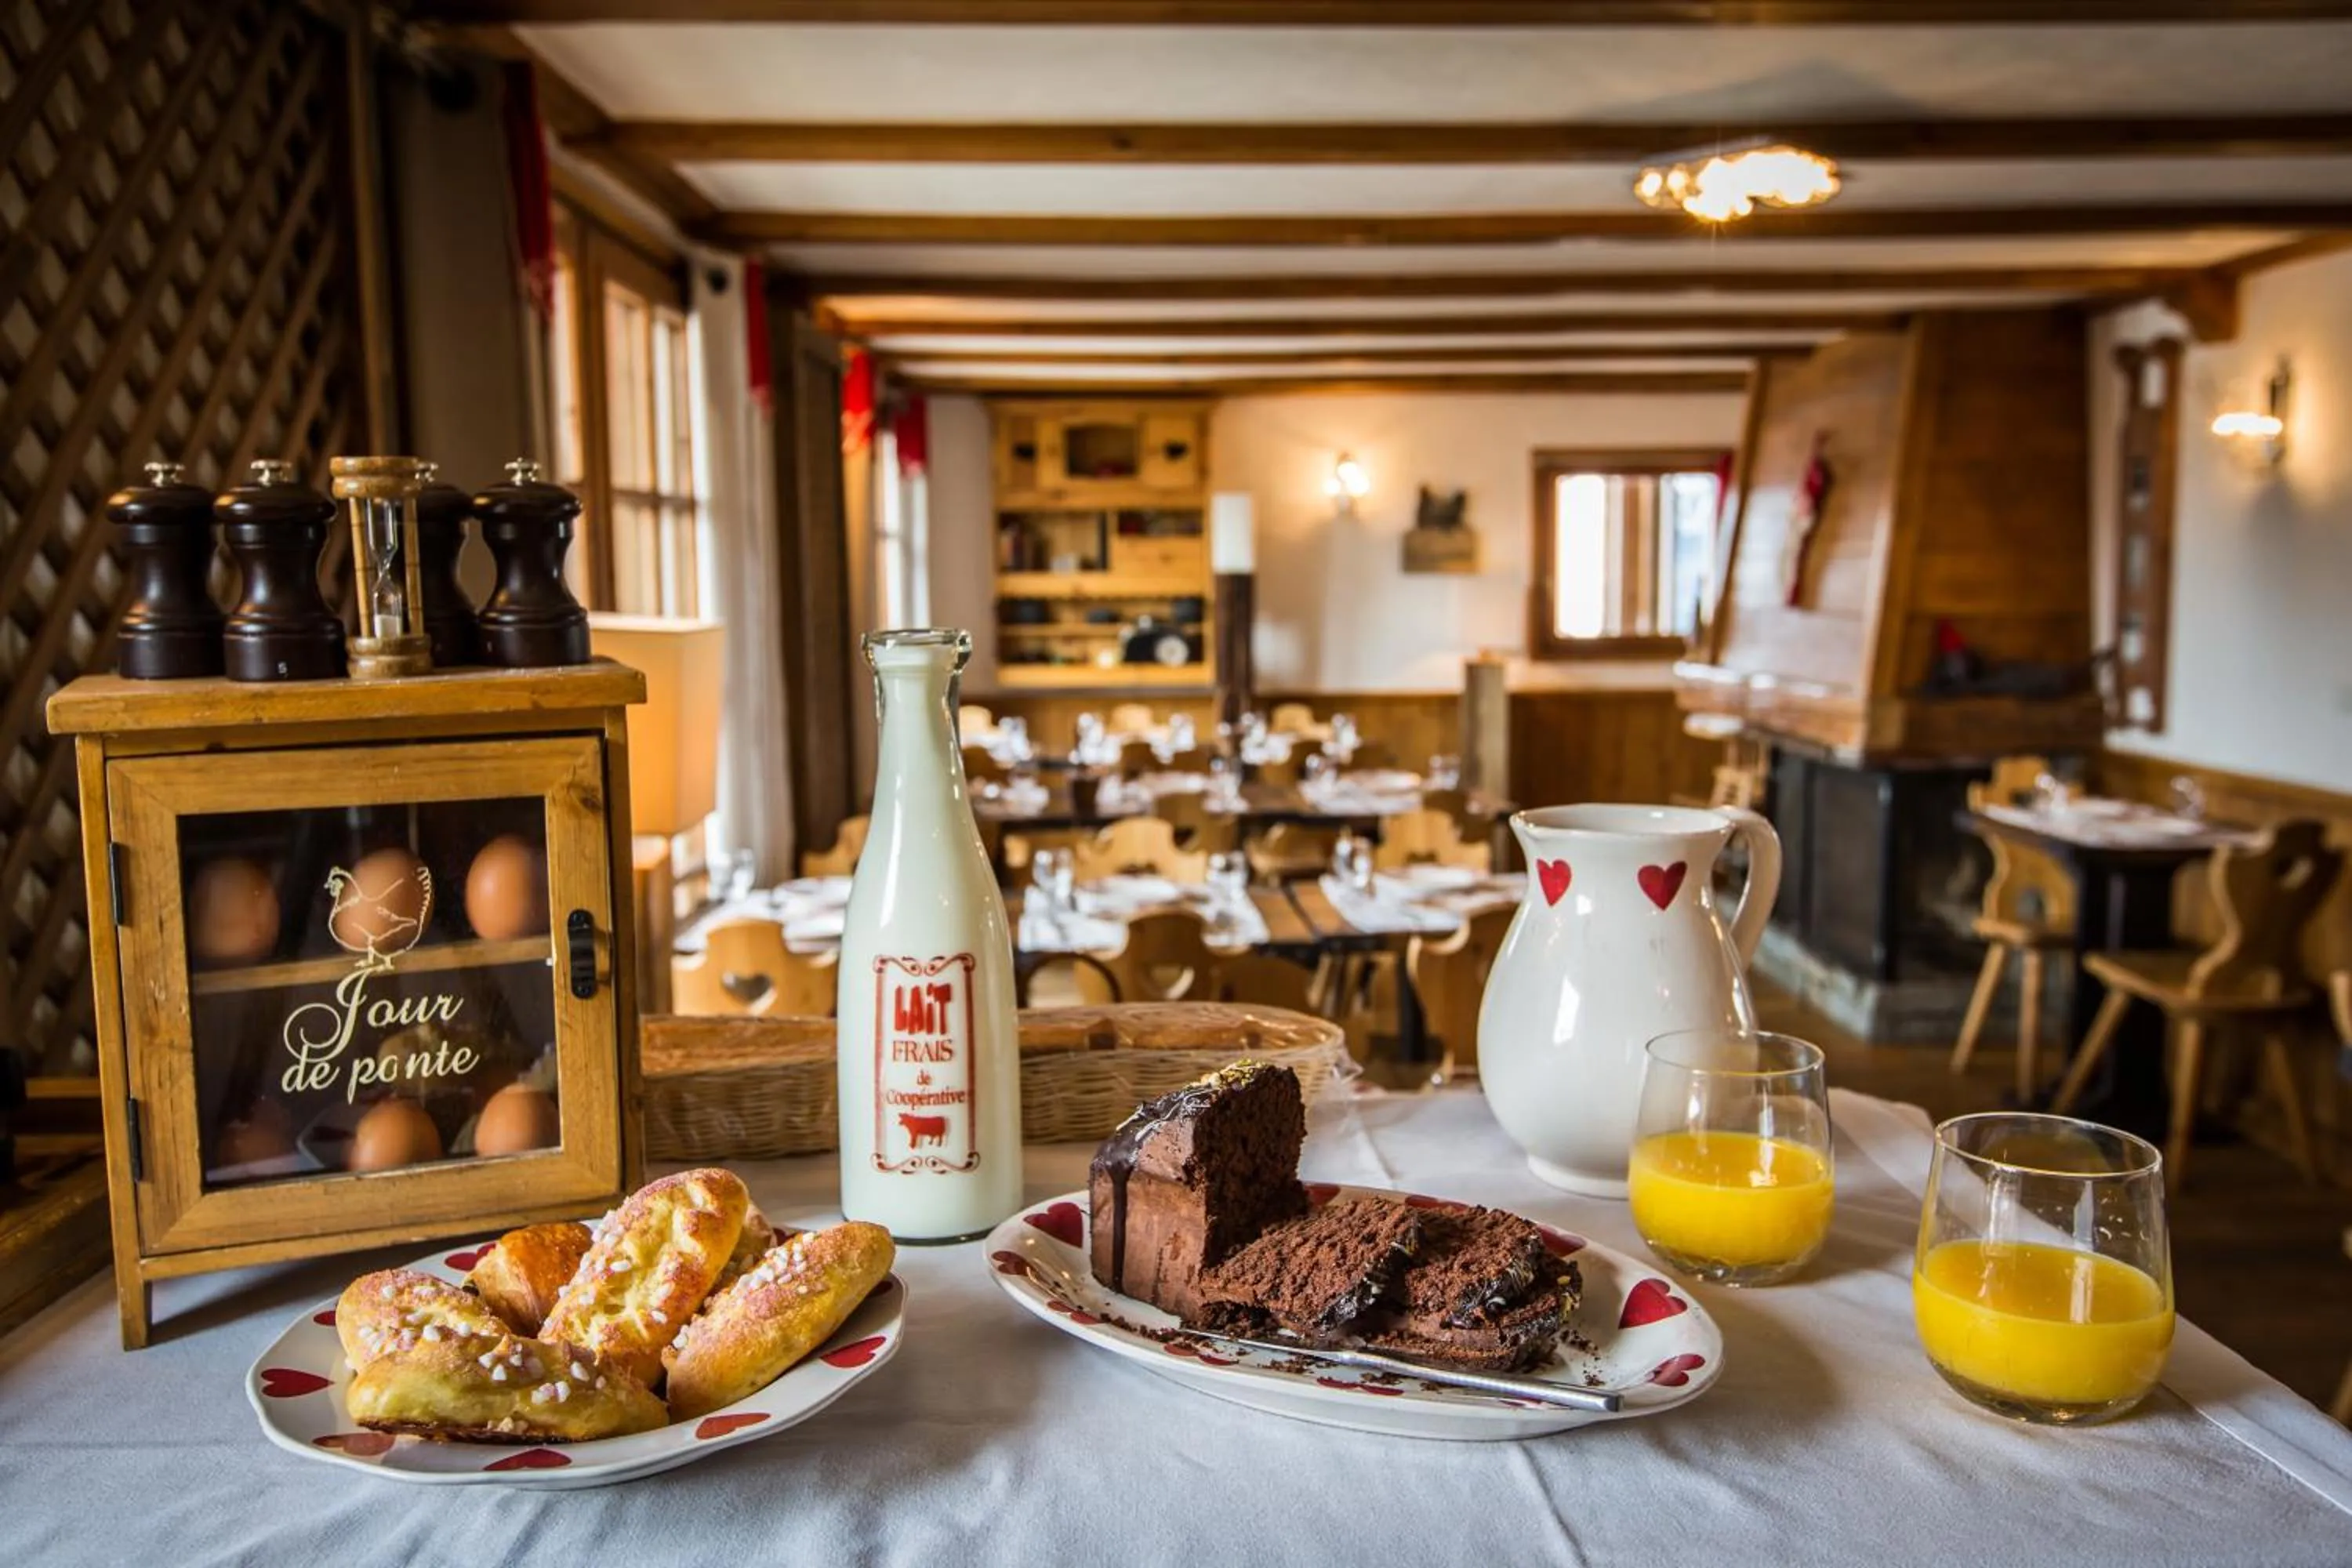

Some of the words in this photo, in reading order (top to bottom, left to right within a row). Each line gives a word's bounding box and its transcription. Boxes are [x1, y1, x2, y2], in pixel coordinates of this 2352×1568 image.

[284, 964, 464, 1062] Jour
[892, 1039, 954, 1062] FRAIS
[281, 1044, 340, 1093] de
[347, 1040, 481, 1105] ponte
[916, 1069, 932, 1086] de
[886, 1086, 966, 1110] Coopérative
